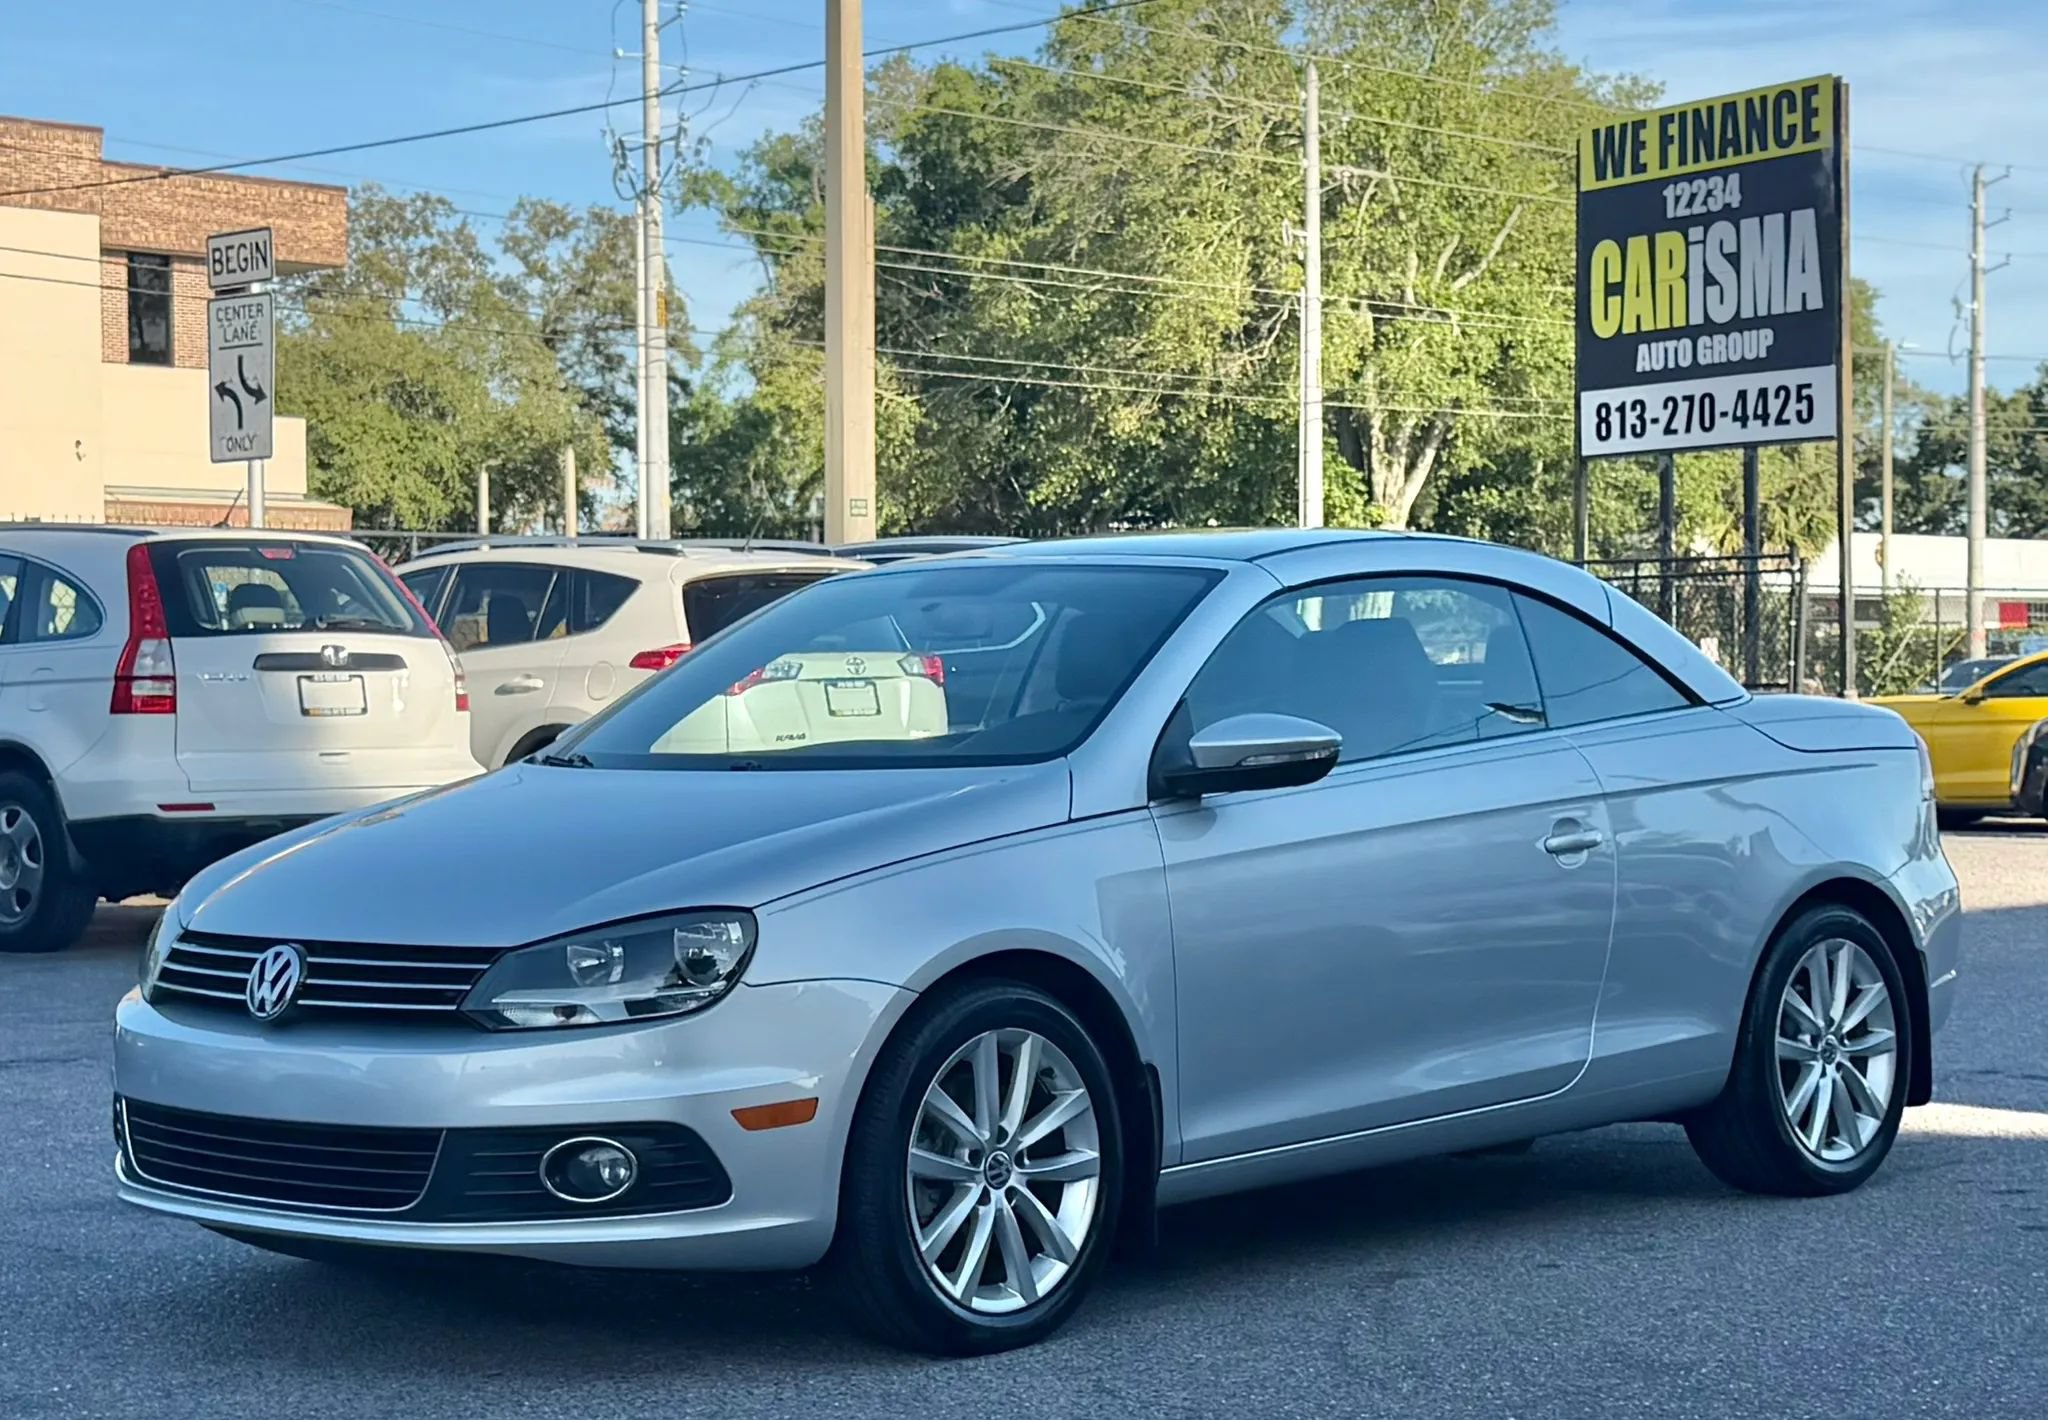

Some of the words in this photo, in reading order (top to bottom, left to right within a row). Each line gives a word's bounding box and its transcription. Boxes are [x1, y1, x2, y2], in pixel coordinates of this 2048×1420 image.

[1591, 118, 1648, 182] WE
[1658, 83, 1820, 170] FINANCE
[1662, 172, 1742, 219] 12234
[211, 239, 268, 277] BEGIN
[1590, 207, 1824, 339] CARiSMA
[215, 303, 264, 323] CENTER
[223, 325, 258, 344] LANE
[1635, 337, 1693, 373] AUTO
[1697, 328, 1775, 366] GROUP
[1594, 382, 1815, 442] 813-270-4425
[225, 435, 256, 453] ONLY
